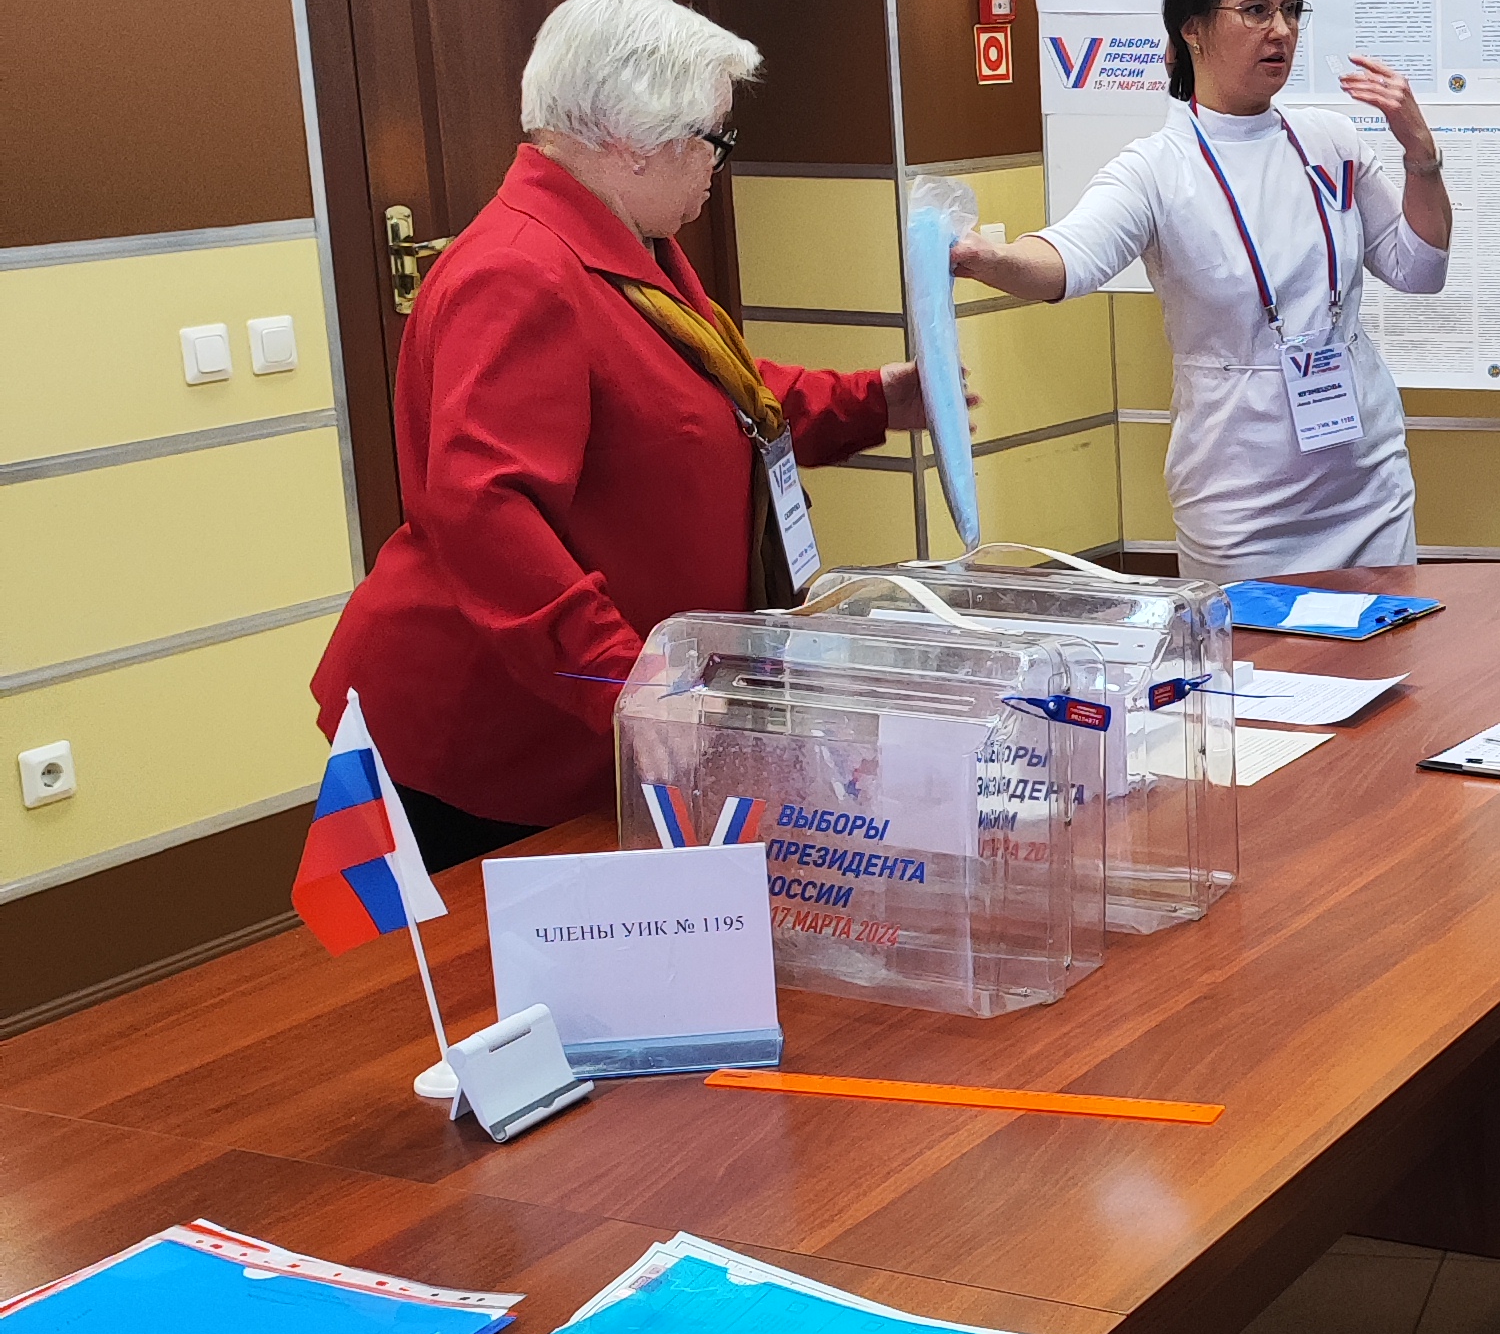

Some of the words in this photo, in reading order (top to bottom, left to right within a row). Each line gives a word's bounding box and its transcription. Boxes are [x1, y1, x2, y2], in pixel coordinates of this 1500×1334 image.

[1109, 38, 1162, 48] ВЫБОРЫ
[1099, 67, 1145, 78] РОССИИ
[1103, 53, 1165, 64] ПРЕЗИДЕН
[1117, 80, 1145, 91] МАРТА
[777, 804, 890, 841] ВЫБОРЫ
[766, 839, 926, 884] ПРЕЗИДЕНТА
[768, 874, 854, 908] ОССИИ
[535, 923, 615, 943] ЧЛЕНЫ
[622, 920, 667, 938] УИК
[674, 918, 696, 934] №
[703, 914, 745, 932] 1195
[792, 910, 854, 939] МАРТА
[855, 920, 900, 946] 2024
